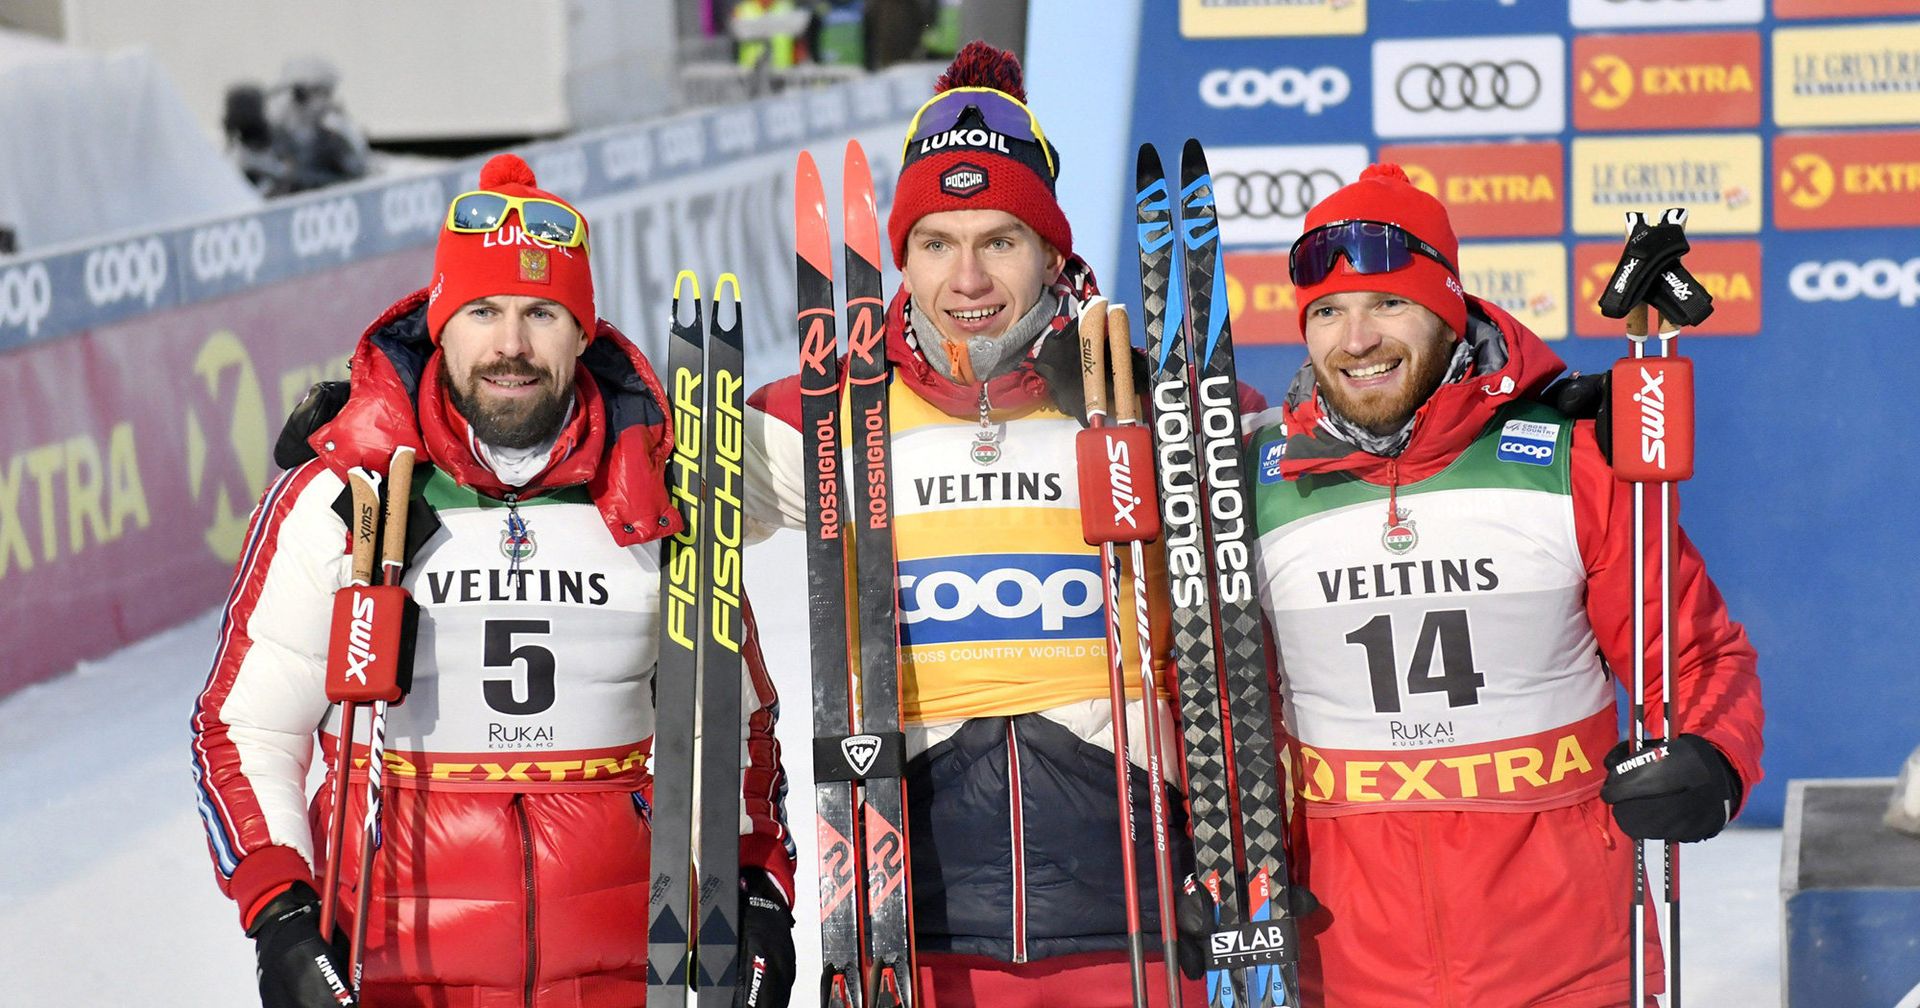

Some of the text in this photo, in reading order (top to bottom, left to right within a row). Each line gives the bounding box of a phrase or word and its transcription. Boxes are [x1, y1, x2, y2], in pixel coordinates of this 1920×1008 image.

[1199, 66, 1350, 114] coop
[1642, 64, 1753, 95] EXTRA
[920, 129, 1010, 154] LUKOIL
[1446, 173, 1554, 202] EXTRA
[1844, 163, 1920, 193] EXTR
[85, 235, 168, 308] coop
[192, 219, 265, 282] coop
[0, 262, 51, 337] op
[864, 400, 888, 530] ROSSIGNOL
[1500, 442, 1552, 459] coop
[816, 411, 839, 541] ROSSIGNOL
[914, 472, 1062, 506] VELTINS
[0, 422, 151, 580] XTRA
[667, 367, 703, 652] FISCHER
[711, 368, 743, 654] FISCHER
[427, 569, 609, 605] VELTINS
[899, 568, 1103, 631] coop
[1317, 558, 1499, 603] VELTINS
[482, 619, 556, 716] 5
[901, 645, 1108, 665] CROSS COUNTRY WORLD CU
[1344, 608, 1485, 714] 14
[489, 722, 553, 742] RUKA!
[1390, 720, 1454, 740] RUKA!
[1392, 737, 1455, 747] KUUSAMO
[1345, 734, 1592, 801] EXTRA
[1213, 951, 1285, 966] SELECT
